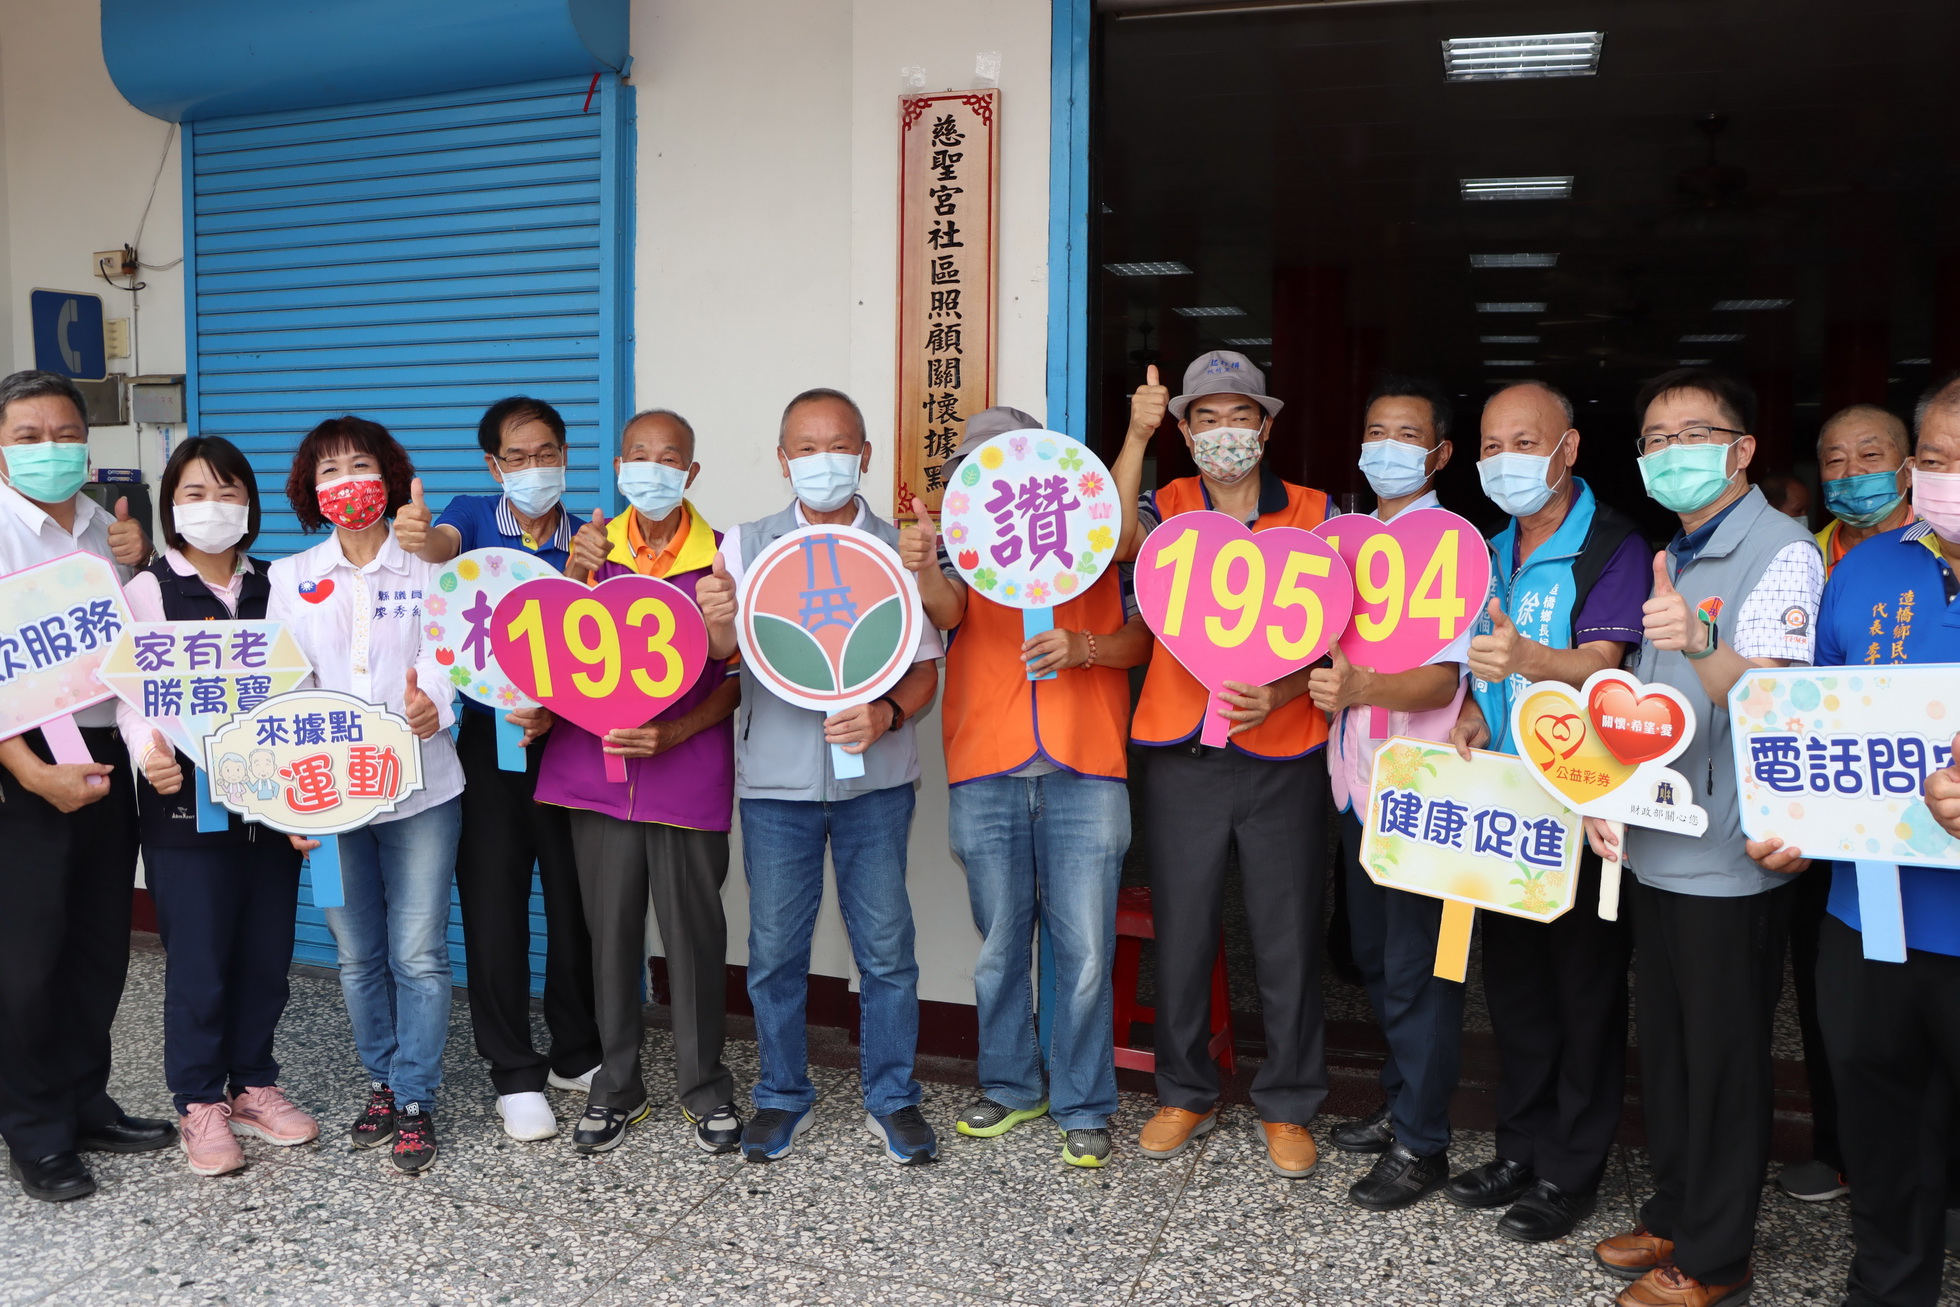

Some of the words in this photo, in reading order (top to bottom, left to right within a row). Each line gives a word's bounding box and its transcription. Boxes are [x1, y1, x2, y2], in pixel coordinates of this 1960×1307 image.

[984, 474, 1081, 572] 讚
[1154, 528, 1332, 661] 195
[1324, 529, 1466, 642] 94
[134, 629, 268, 672] 家有老
[507, 597, 684, 699] 193
[143, 674, 272, 718] 勝萬寶
[255, 710, 364, 747] 來據點
[278, 745, 401, 814] 運動
[1556, 765, 1611, 788] 公益彩券
[1379, 789, 1566, 867] 健康促進
[1630, 804, 1699, 827] 財政部關心您
